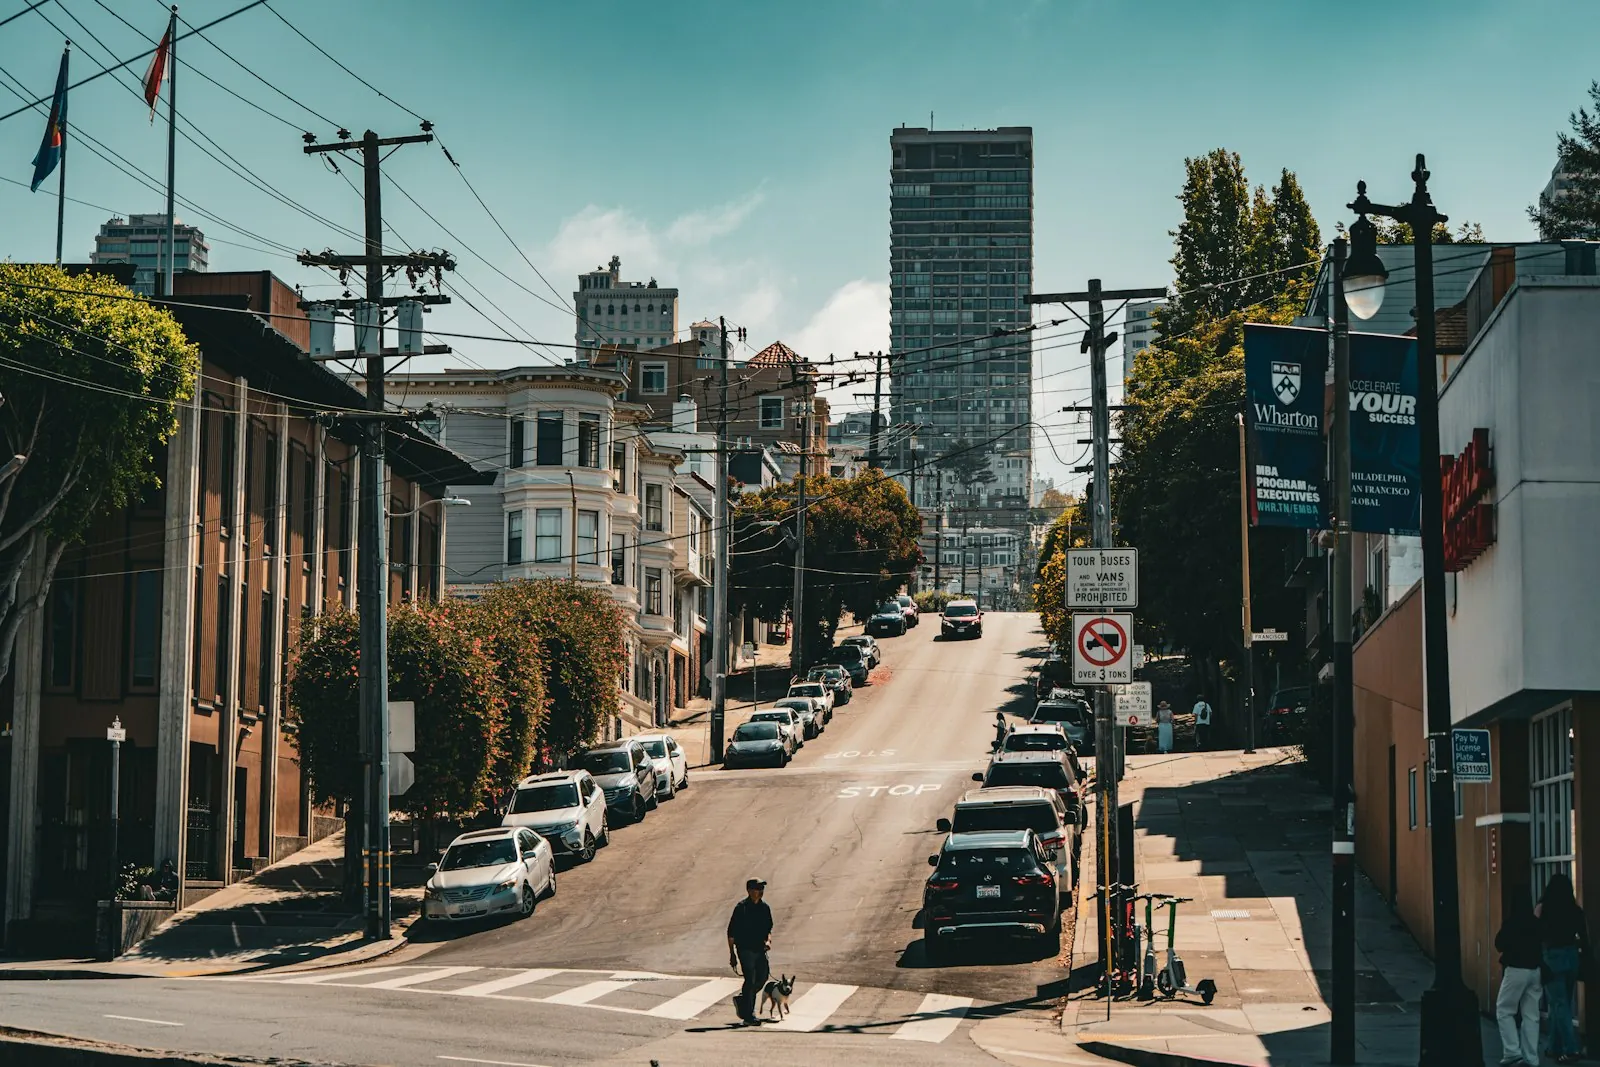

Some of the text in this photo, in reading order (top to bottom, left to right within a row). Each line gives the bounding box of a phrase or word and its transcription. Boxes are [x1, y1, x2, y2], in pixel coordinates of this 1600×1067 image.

[1349, 391, 1417, 415] YOUR
[1253, 403, 1318, 429] Wharton
[1369, 413, 1416, 425] SUCCESS
[1256, 465, 1279, 477] MBA
[1351, 472, 1407, 483] HILADELPHIA
[1256, 476, 1317, 492] PROGRAM for
[1256, 488, 1320, 503] EXECUTIVES
[1351, 485, 1410, 496] AN FRANCISCO
[1257, 501, 1319, 514] WHR.TN/EMBA
[1072, 556, 1130, 566] TOUR BUSES
[1096, 572, 1125, 582] VANS
[1075, 592, 1128, 602] PROHIBITED
[1099, 669, 1106, 680] 3
[1117, 684, 1124, 694] 2
[1455, 733, 1479, 744] Pay by
[1455, 743, 1481, 752] License
[824, 749, 898, 759] STOP
[1456, 752, 1474, 761] Plate
[837, 784, 942, 798] STOP
